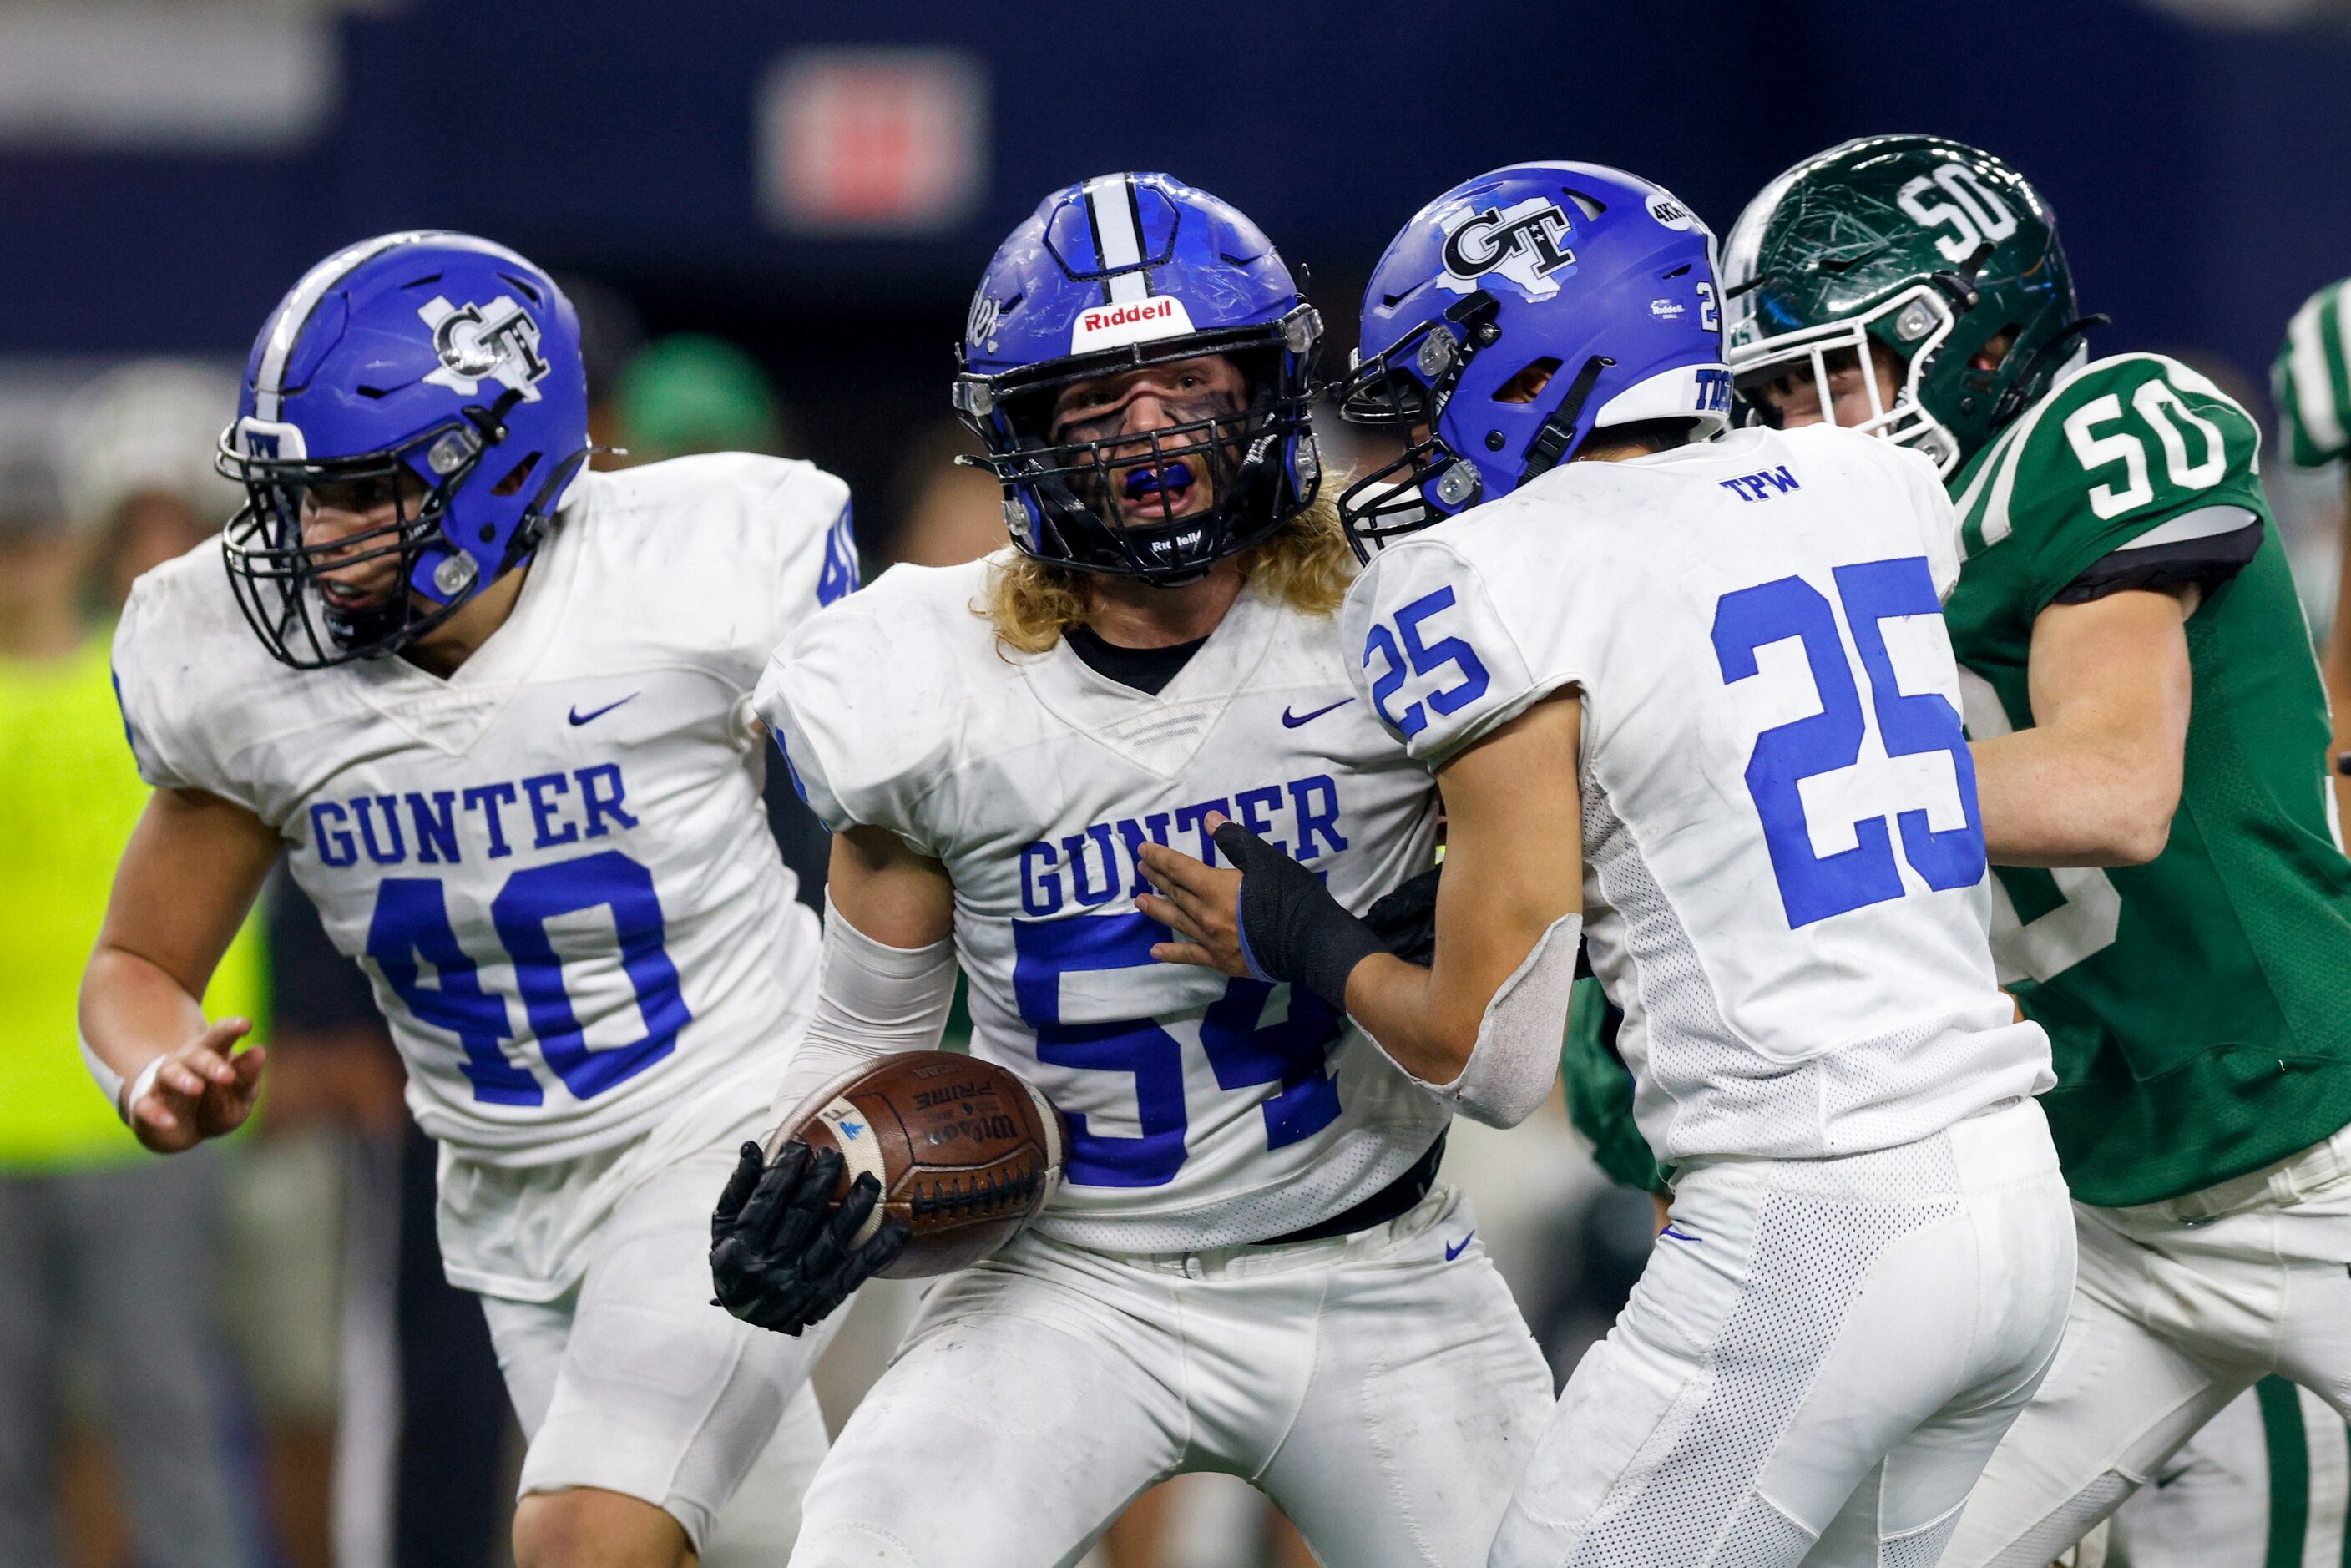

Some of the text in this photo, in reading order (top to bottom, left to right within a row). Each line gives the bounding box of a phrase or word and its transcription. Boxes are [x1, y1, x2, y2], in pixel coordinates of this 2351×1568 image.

[1443, 206, 1576, 280] GT
[1897, 164, 2018, 263] 50
[433, 303, 551, 387] GT
[1085, 300, 1171, 331] Riddell
[1652, 304, 1685, 315] Riddell
[1717, 465, 1800, 502] TPW
[2063, 378, 2227, 521] 50
[1363, 585, 1491, 741] 25
[1711, 556, 1987, 930] 25
[310, 762, 640, 868] GUNTER
[1019, 774, 1349, 918] GUNTER
[366, 849, 694, 1107] 40
[1011, 870, 1344, 1188] 54
[912, 1081, 998, 1111] PRIME
